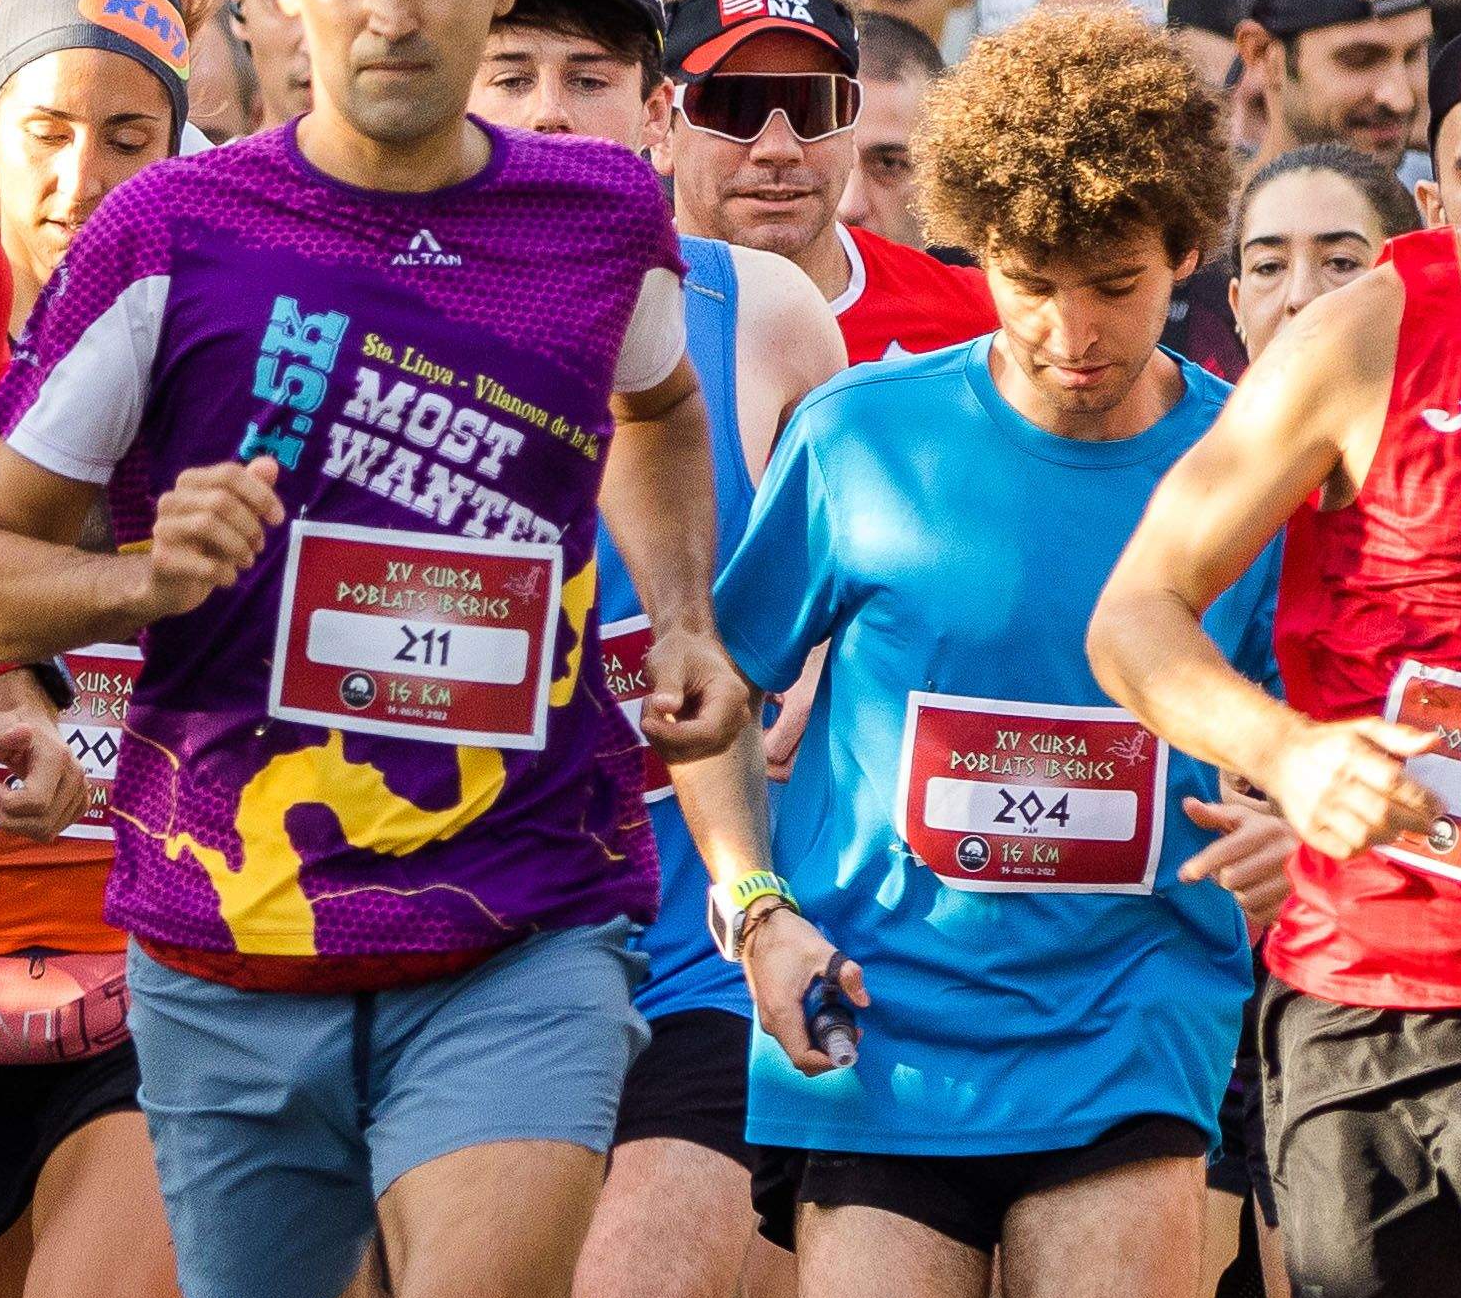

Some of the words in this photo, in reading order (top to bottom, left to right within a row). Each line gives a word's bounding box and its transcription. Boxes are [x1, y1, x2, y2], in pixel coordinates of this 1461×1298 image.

[391, 253, 462, 267] ALTAN
[362, 332, 394, 365] Sta.
[400, 346, 455, 389] Linya
[475, 374, 548, 429] Vilanova
[550, 414, 570, 439] de
[342, 366, 525, 480] MOST
[386, 561, 414, 583] XV
[422, 566, 483, 592] CURSA
[336, 580, 428, 611] POBLATS
[394, 624, 451, 667] 211
[75, 671, 133, 696] CURSA
[388, 681, 412, 702] 16
[421, 685, 452, 707] KM
[996, 730, 1021, 751] XV
[1029, 733, 1088, 757] CURSA
[950, 751, 1036, 777] POBLATS
[993, 788, 1071, 827] 204
[1001, 842, 1024, 863] 16
[1032, 844, 1061, 864] KM
